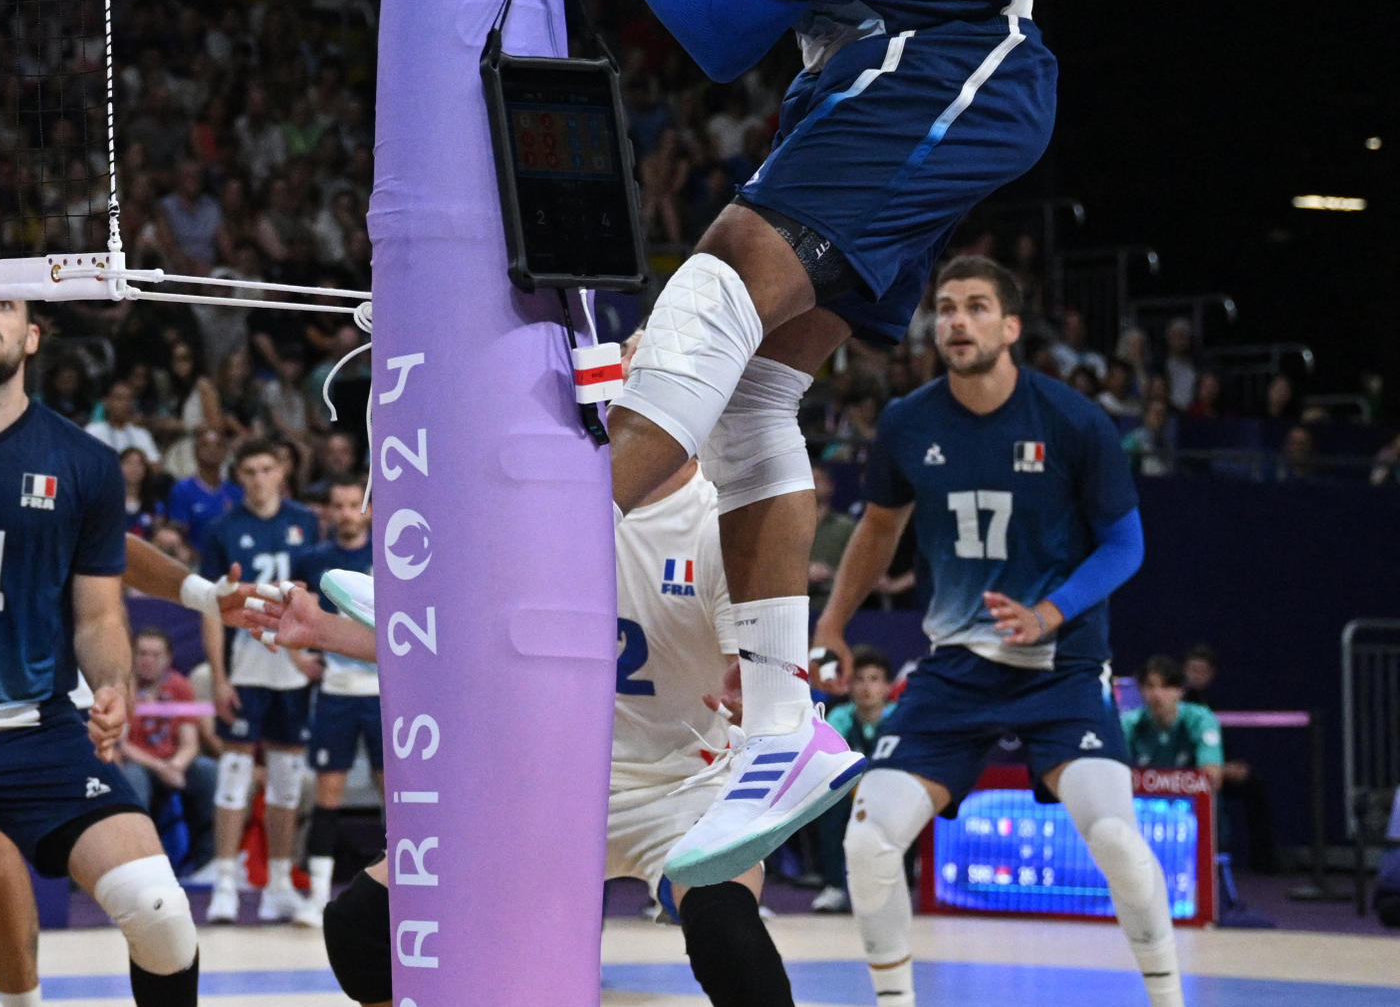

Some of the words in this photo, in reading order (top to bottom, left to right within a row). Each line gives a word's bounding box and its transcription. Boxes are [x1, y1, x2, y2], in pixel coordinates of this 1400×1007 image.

[20, 495, 55, 511] FRA
[378, 352, 437, 657] 2024
[947, 489, 1013, 561] 17
[252, 552, 291, 585] 21
[660, 582, 696, 597] FRA
[615, 617, 656, 697] 2
[1142, 769, 1210, 793] OMEGA
